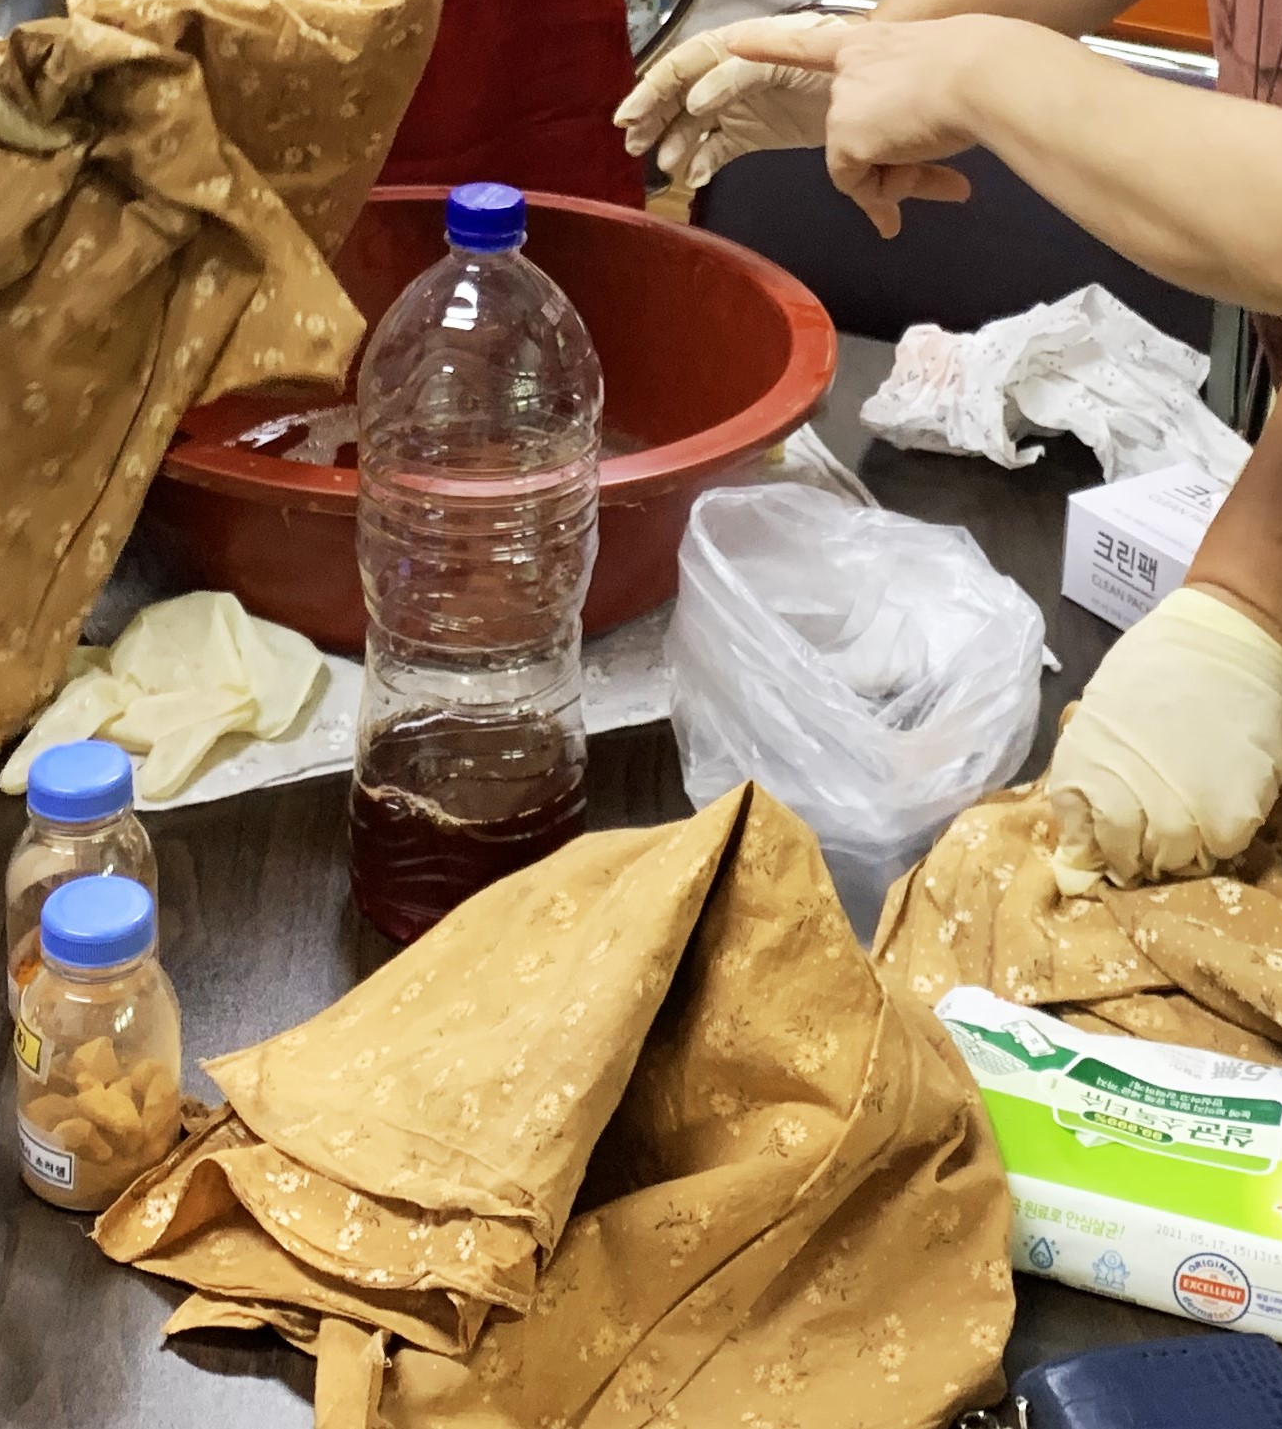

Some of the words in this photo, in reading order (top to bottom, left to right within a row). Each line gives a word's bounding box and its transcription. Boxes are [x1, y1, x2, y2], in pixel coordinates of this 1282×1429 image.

[1093, 530, 1159, 592] 크린팩
[1091, 573, 1125, 602] CLEAN
[1079, 1090, 1129, 1116] 티슈
[1136, 1107, 1187, 1130] 소독
[1188, 1119, 1254, 1148] 살균
[1025, 1200, 1063, 1224] 원료로
[1065, 1210, 1126, 1241] 안심살균!
[1187, 1258, 1240, 1285] ORIGINAL
[1182, 1277, 1243, 1302] EXCELLENT
